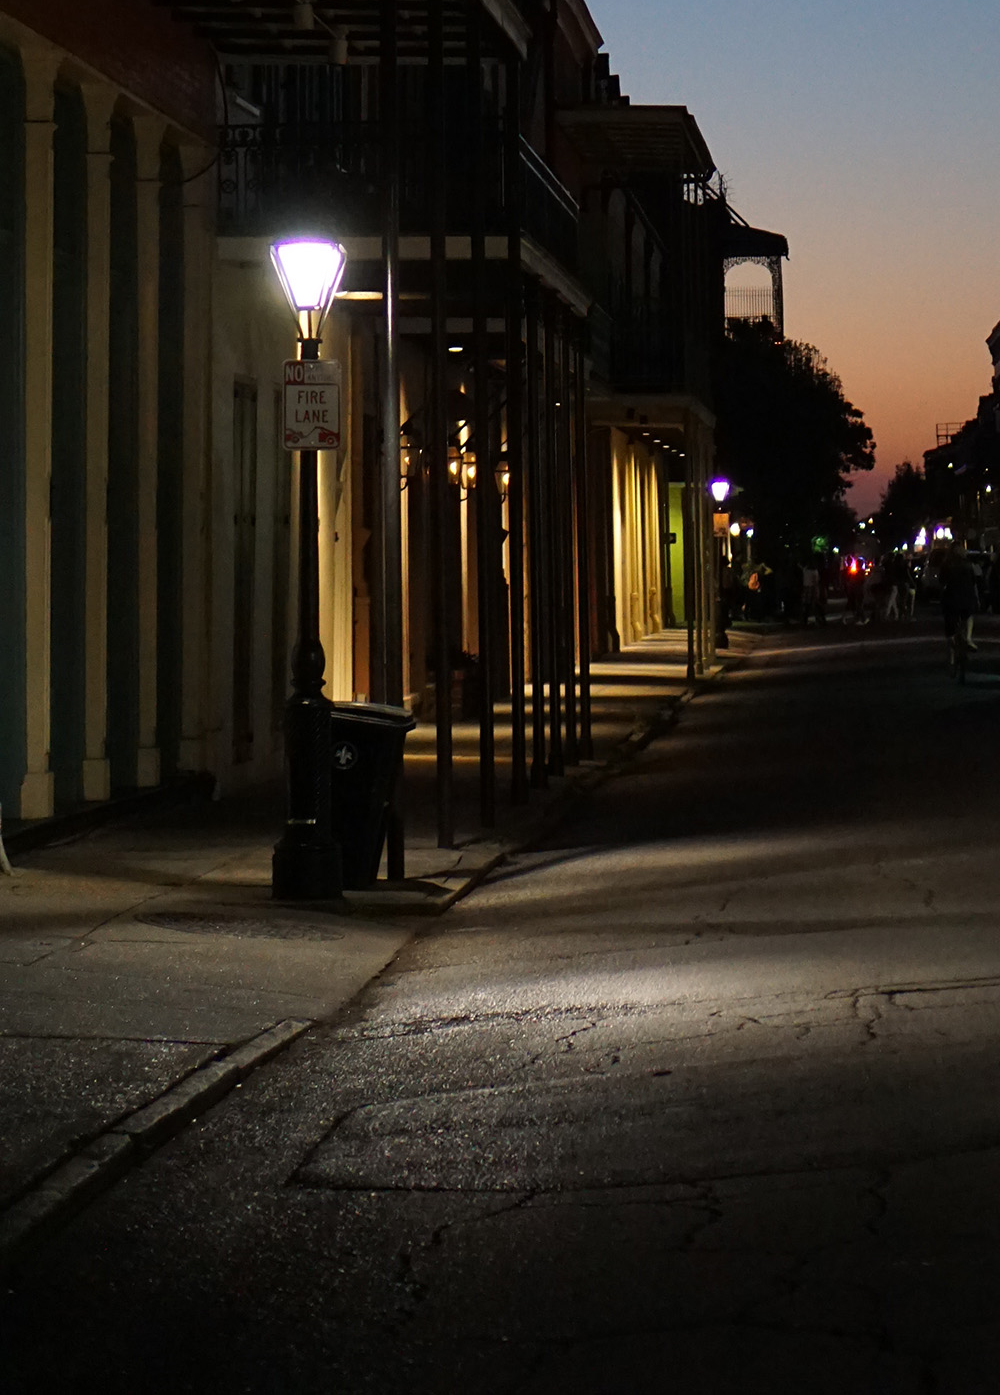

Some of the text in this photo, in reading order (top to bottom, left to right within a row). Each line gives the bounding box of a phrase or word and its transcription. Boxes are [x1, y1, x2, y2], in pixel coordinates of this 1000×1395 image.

[285, 364, 304, 382] NO
[297, 390, 326, 404] FIRE
[295, 409, 329, 423] LANE
